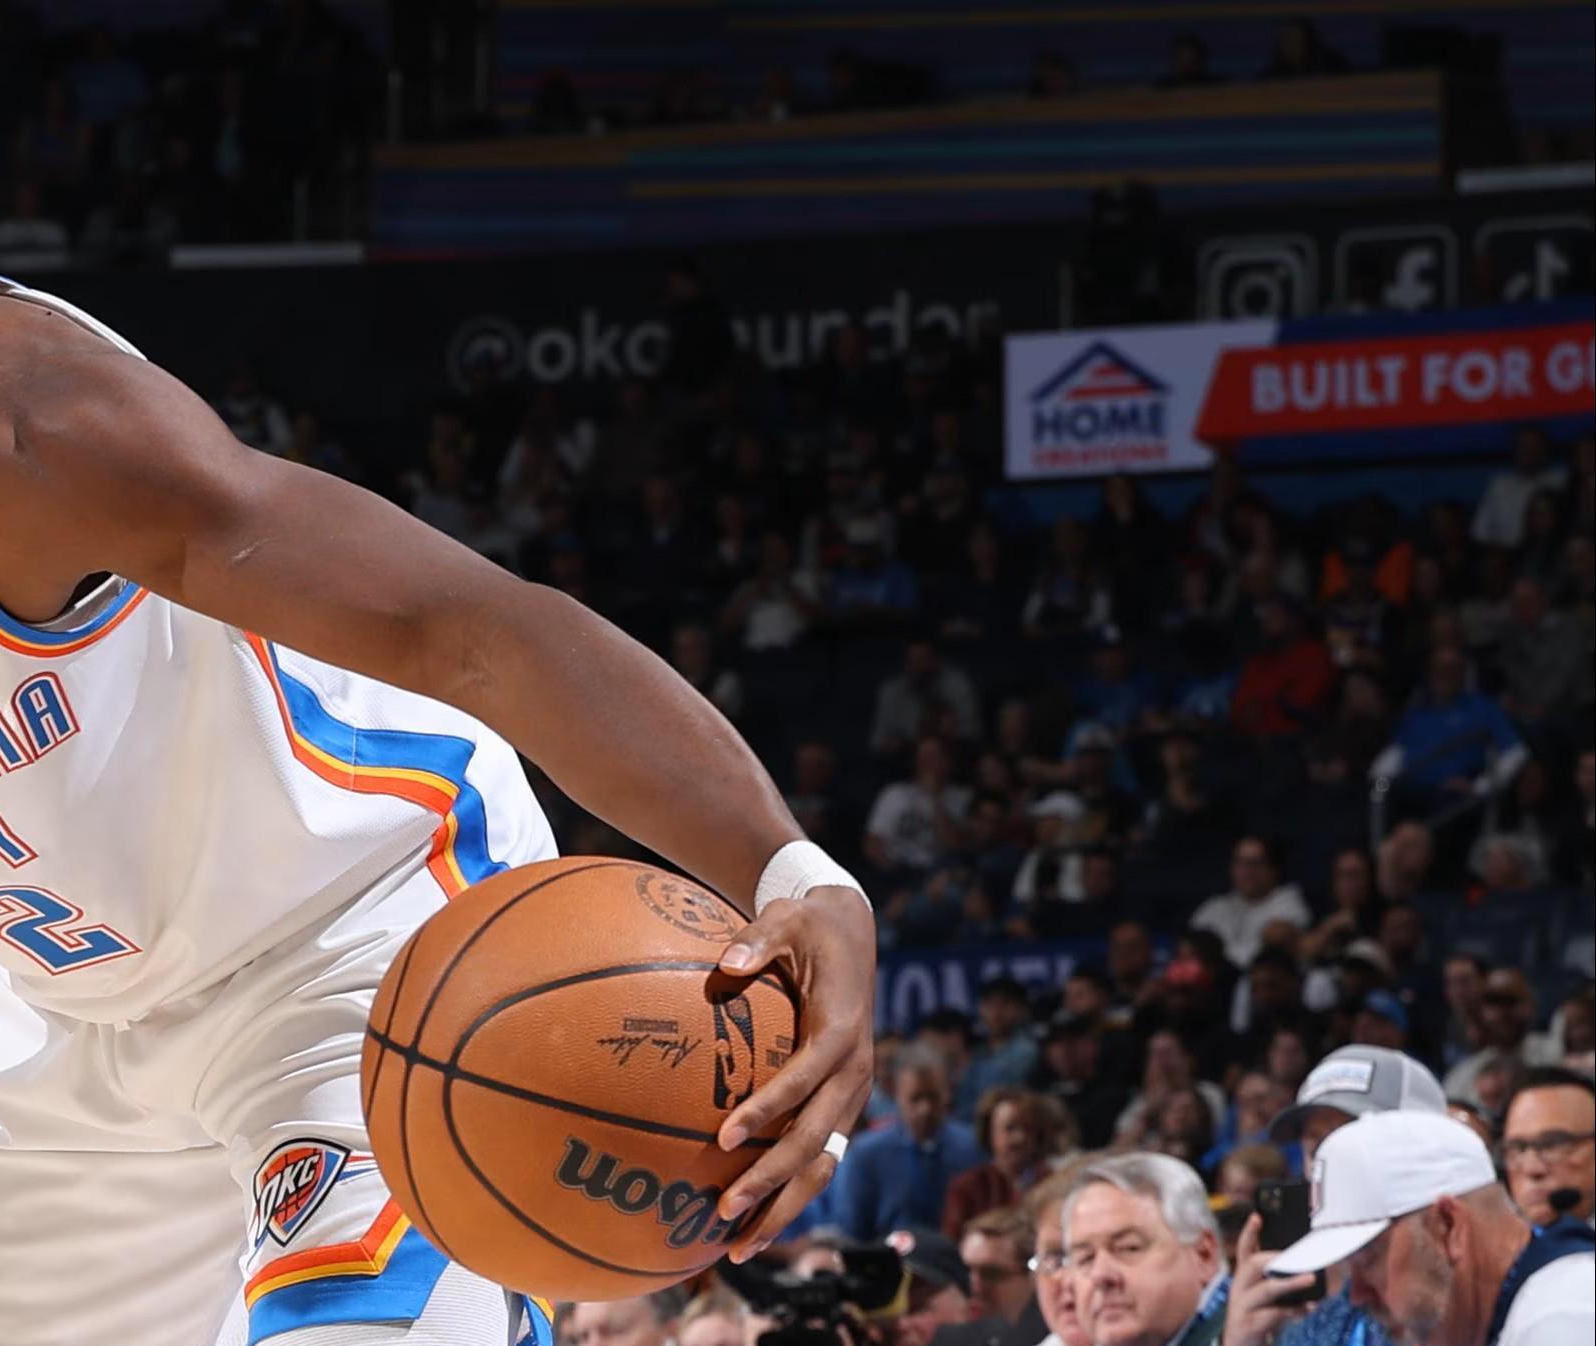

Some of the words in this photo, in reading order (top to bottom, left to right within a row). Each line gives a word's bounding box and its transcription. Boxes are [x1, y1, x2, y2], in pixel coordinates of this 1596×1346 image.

[1251, 355, 1410, 413] BUILT
[1421, 349, 1533, 405] FOR
[1545, 338, 1596, 394] G
[1032, 401, 1164, 442] HOME
[256, 1153, 322, 1242] OKC
